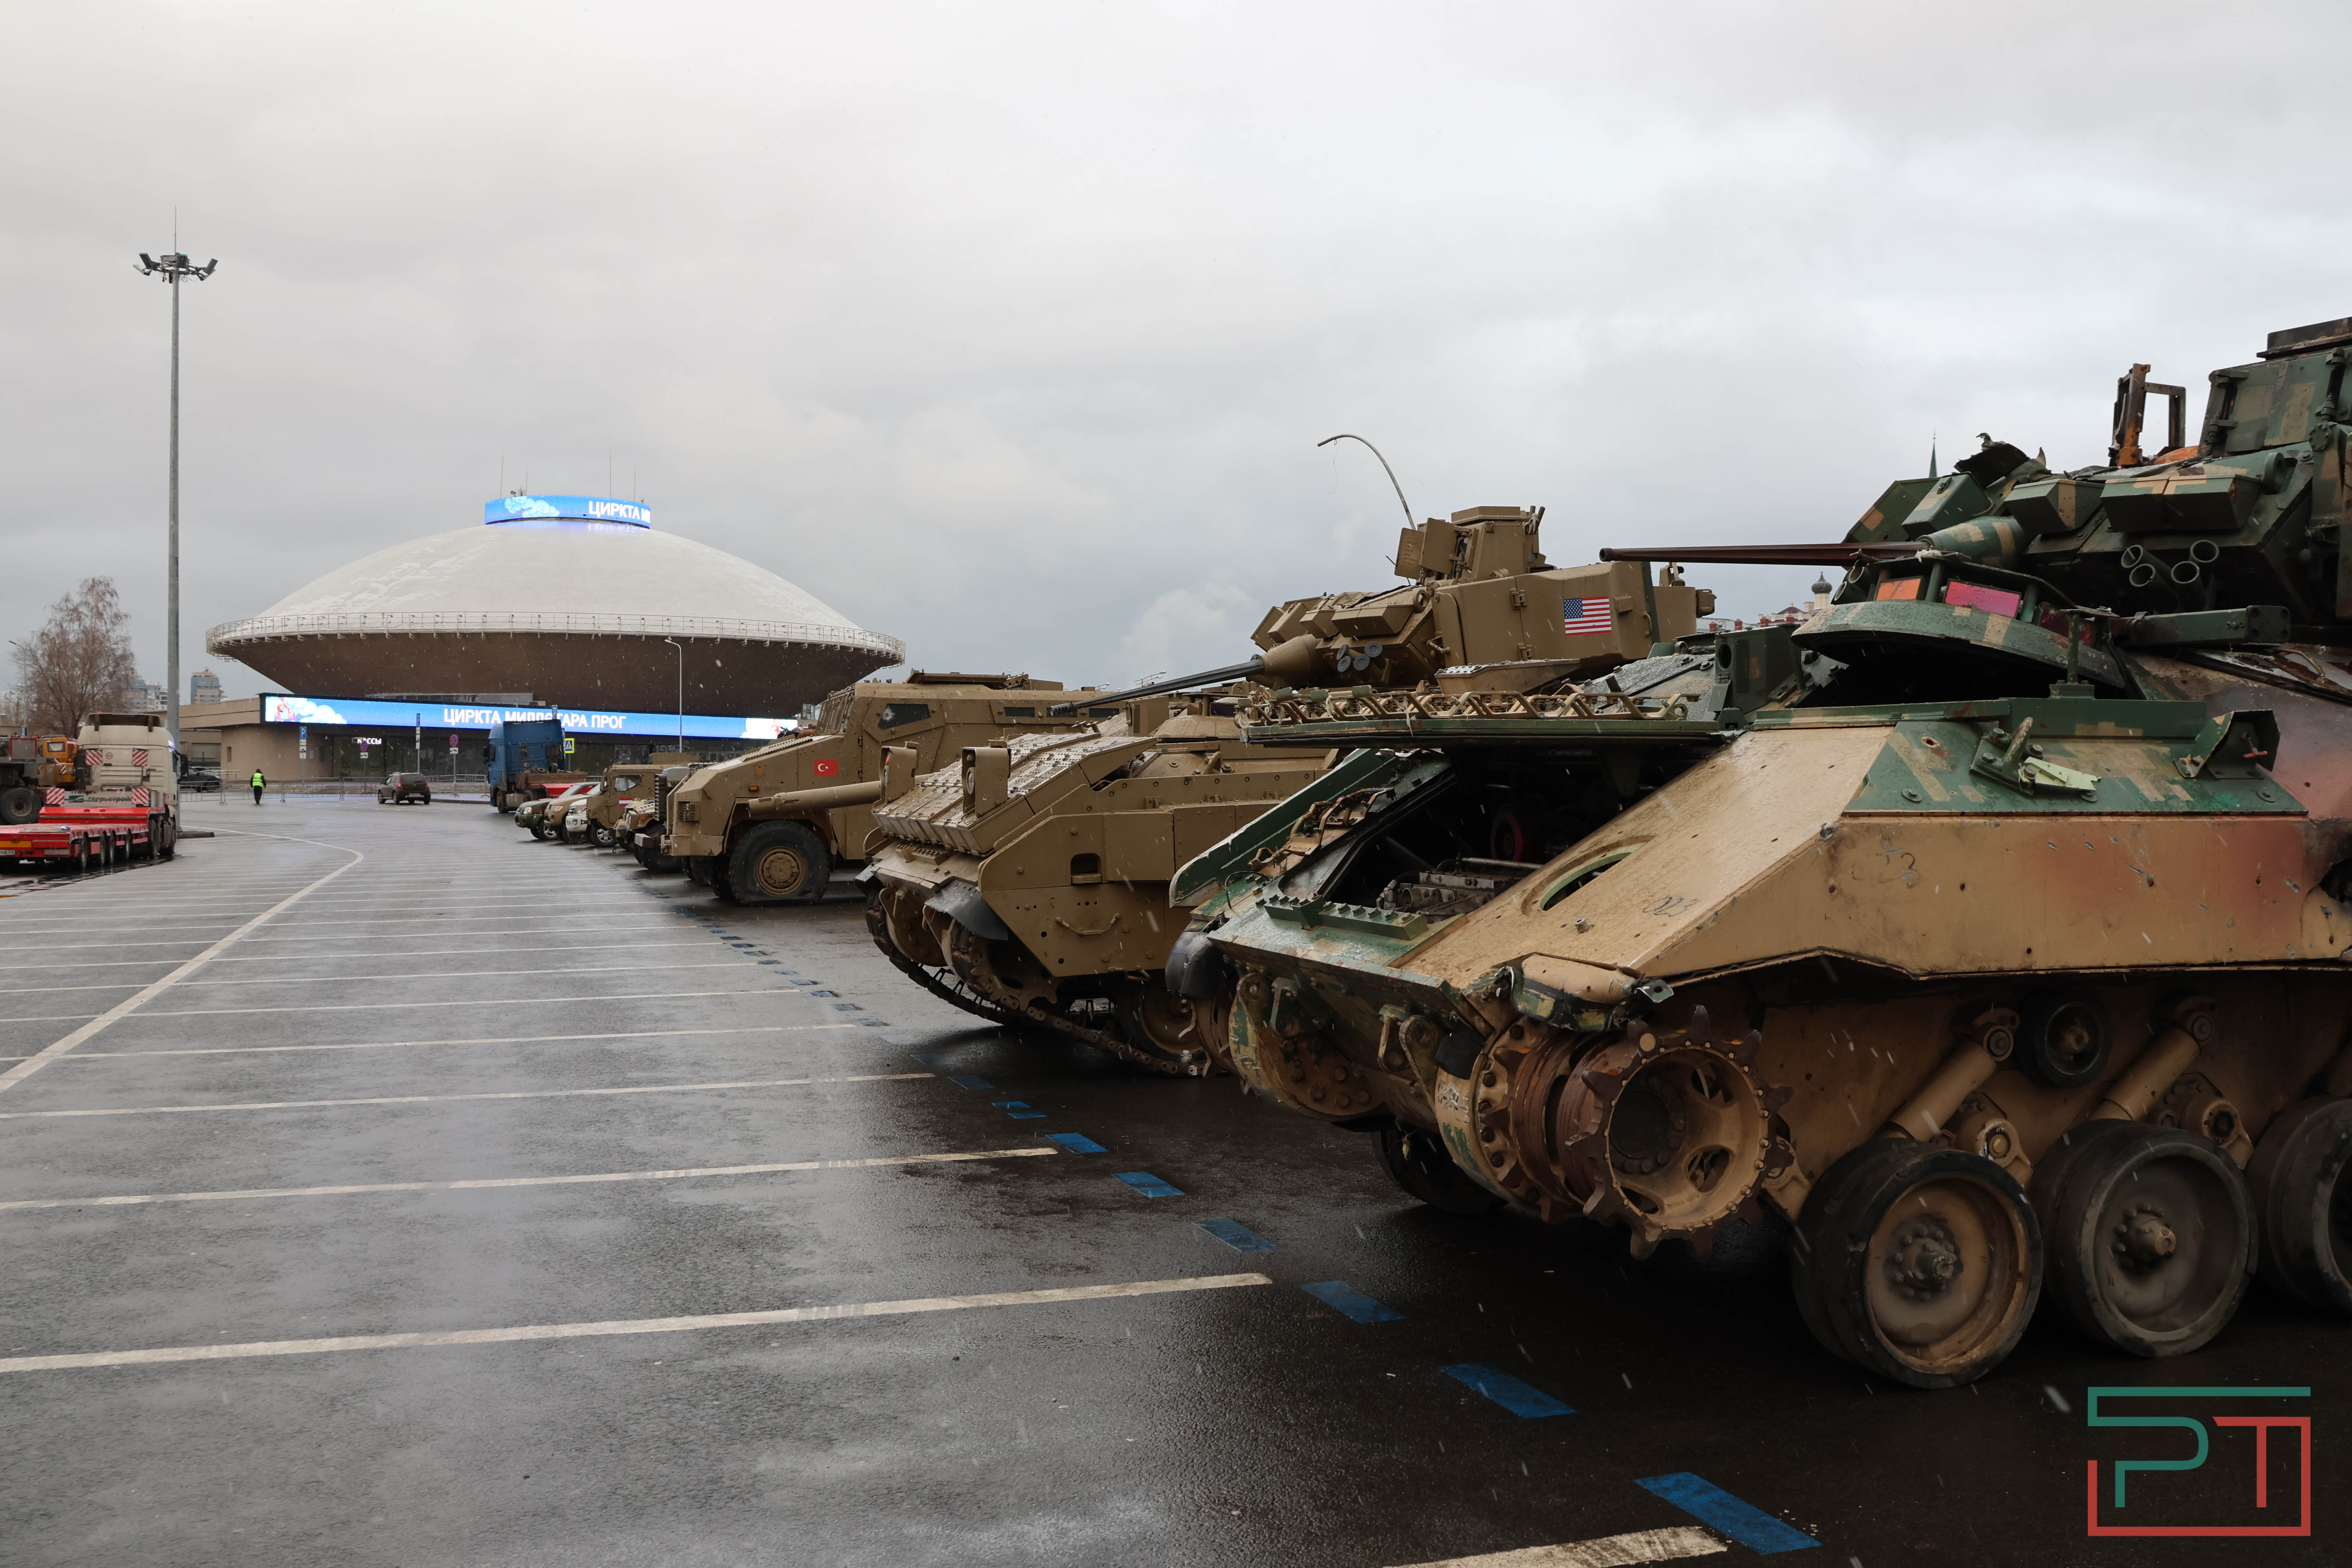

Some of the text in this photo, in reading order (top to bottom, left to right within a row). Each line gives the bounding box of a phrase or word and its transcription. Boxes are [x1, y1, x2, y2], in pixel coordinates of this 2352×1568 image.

[589, 501, 640, 520] ЦИРКТА
[444, 709, 501, 726] ЦИРКТА
[591, 715, 626, 729] ПРОГ
[301, 728, 305, 737] P
